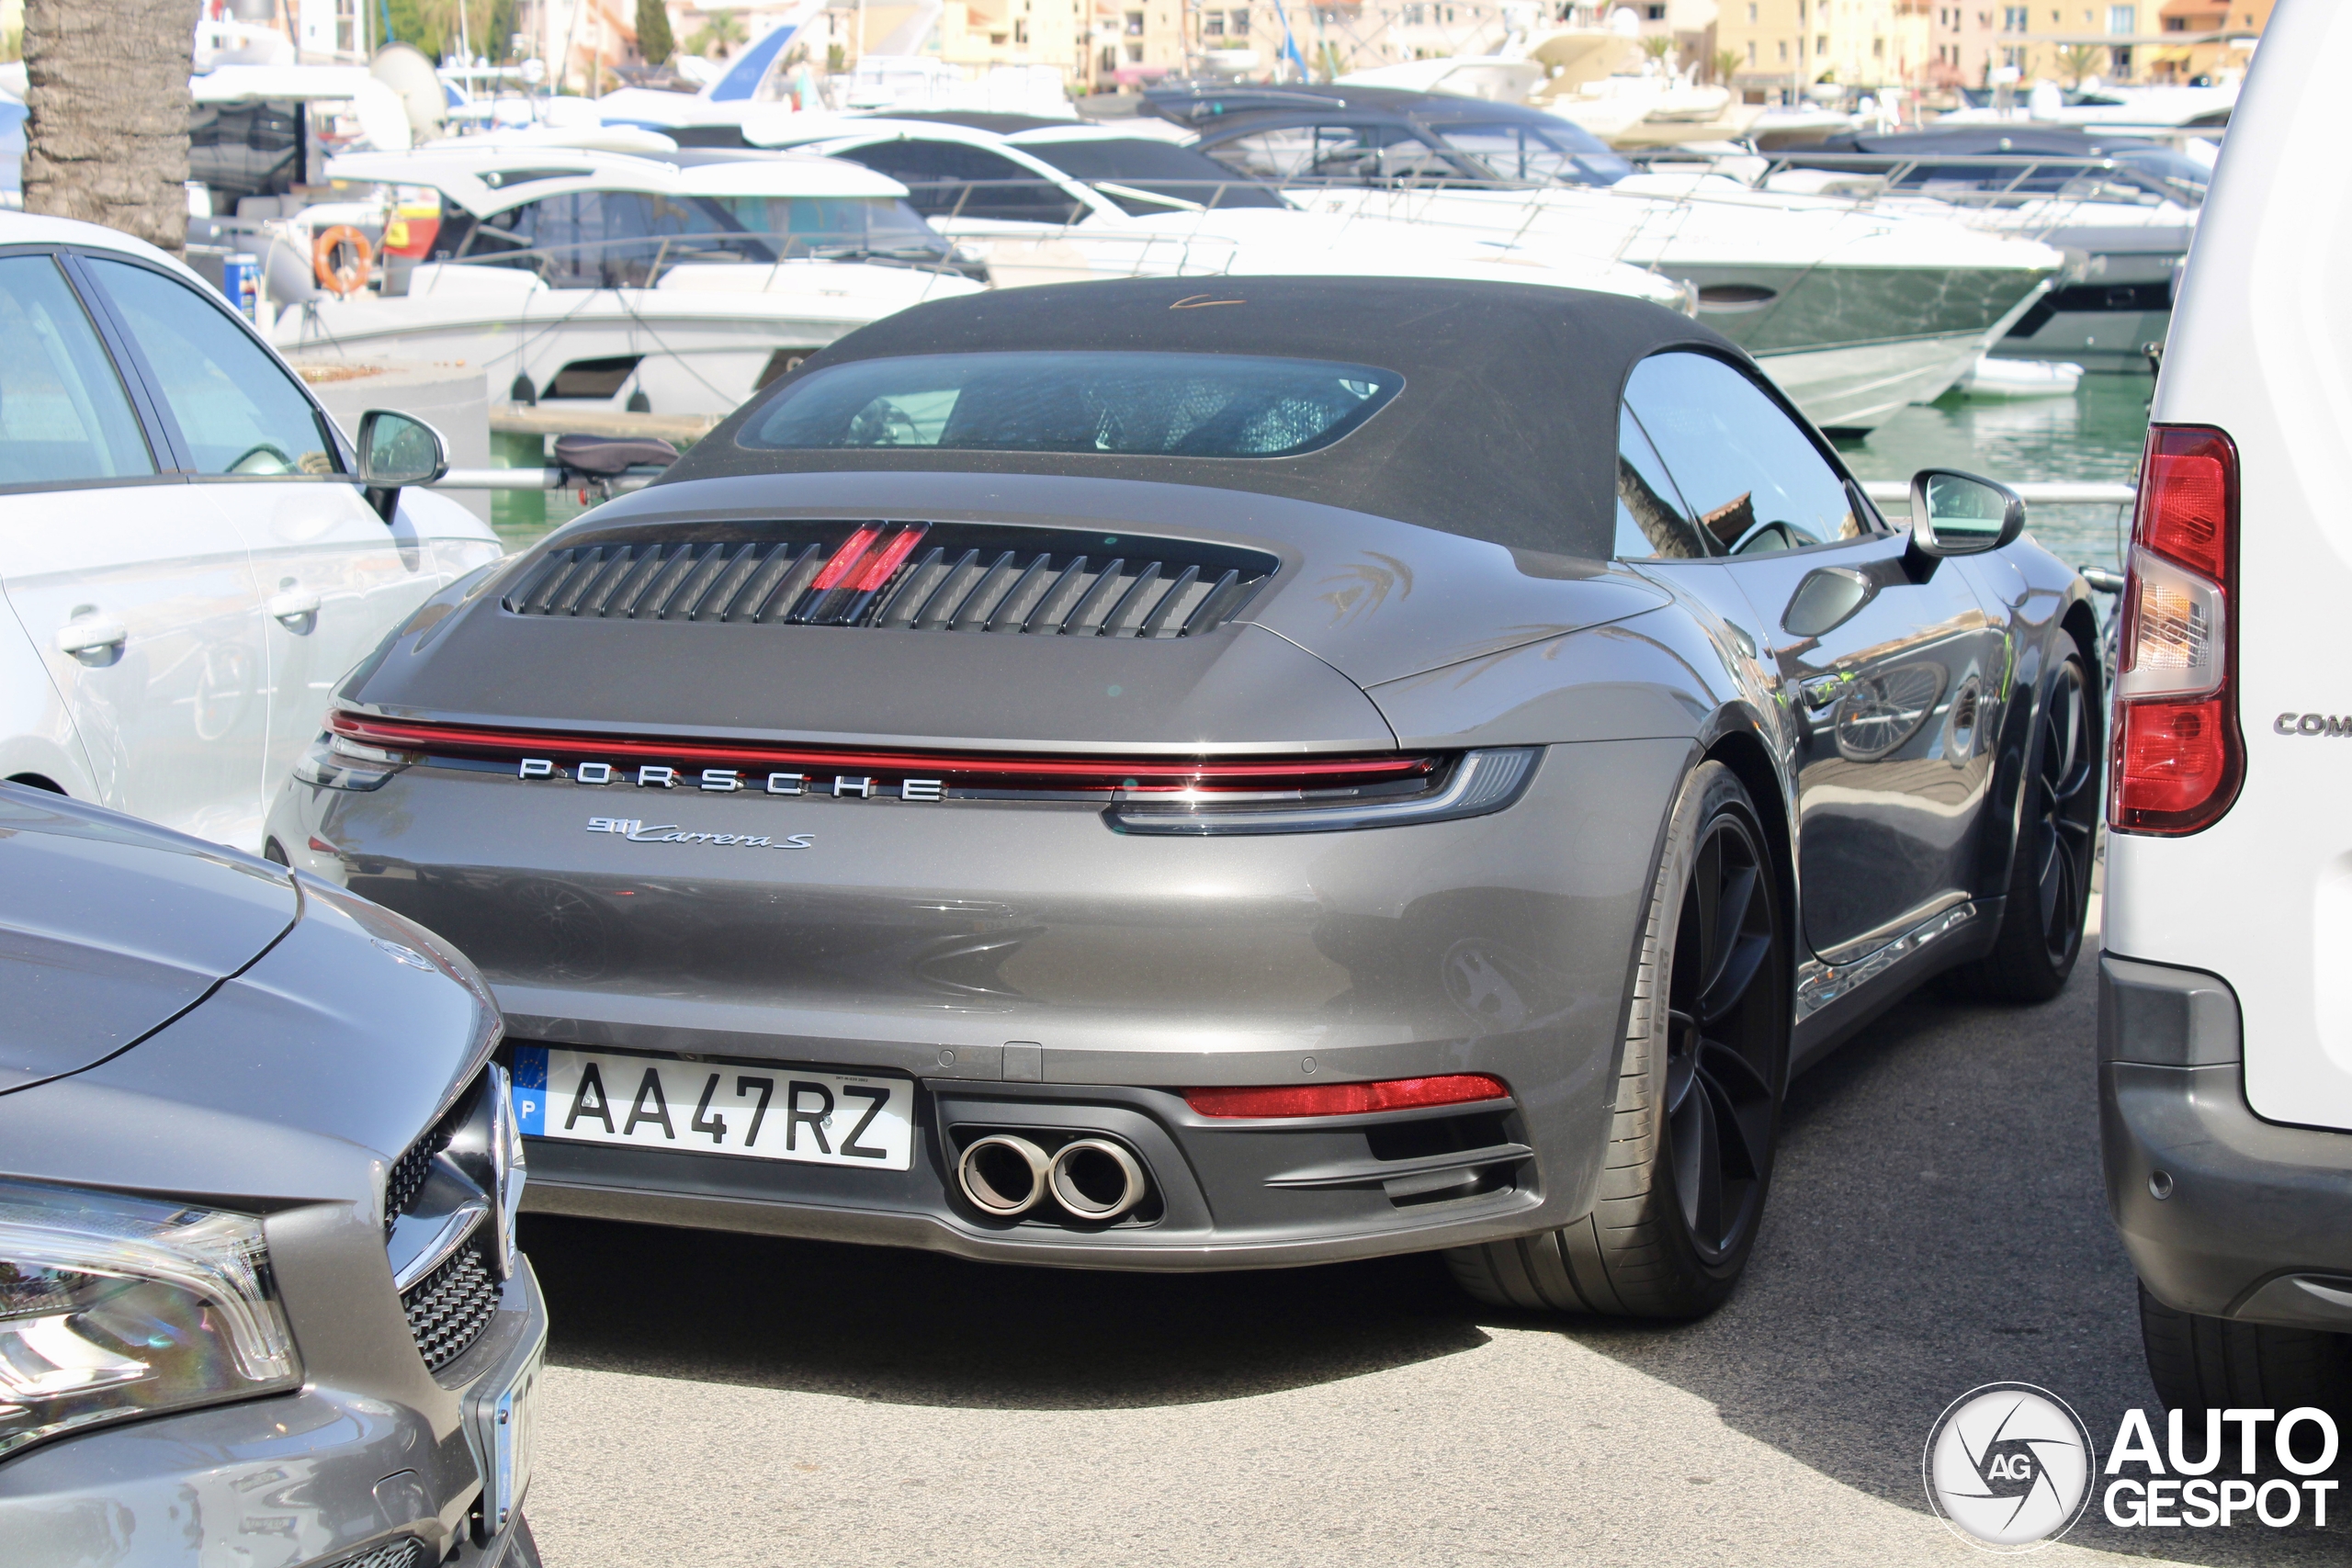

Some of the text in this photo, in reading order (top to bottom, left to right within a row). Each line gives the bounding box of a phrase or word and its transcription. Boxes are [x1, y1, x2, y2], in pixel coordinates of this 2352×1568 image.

[519, 758, 946, 802] PORSCHE
[586, 817, 816, 849] 911 Carrera S
[1654, 948, 1669, 1034] PIRELLI
[521, 1100, 536, 1119] P
